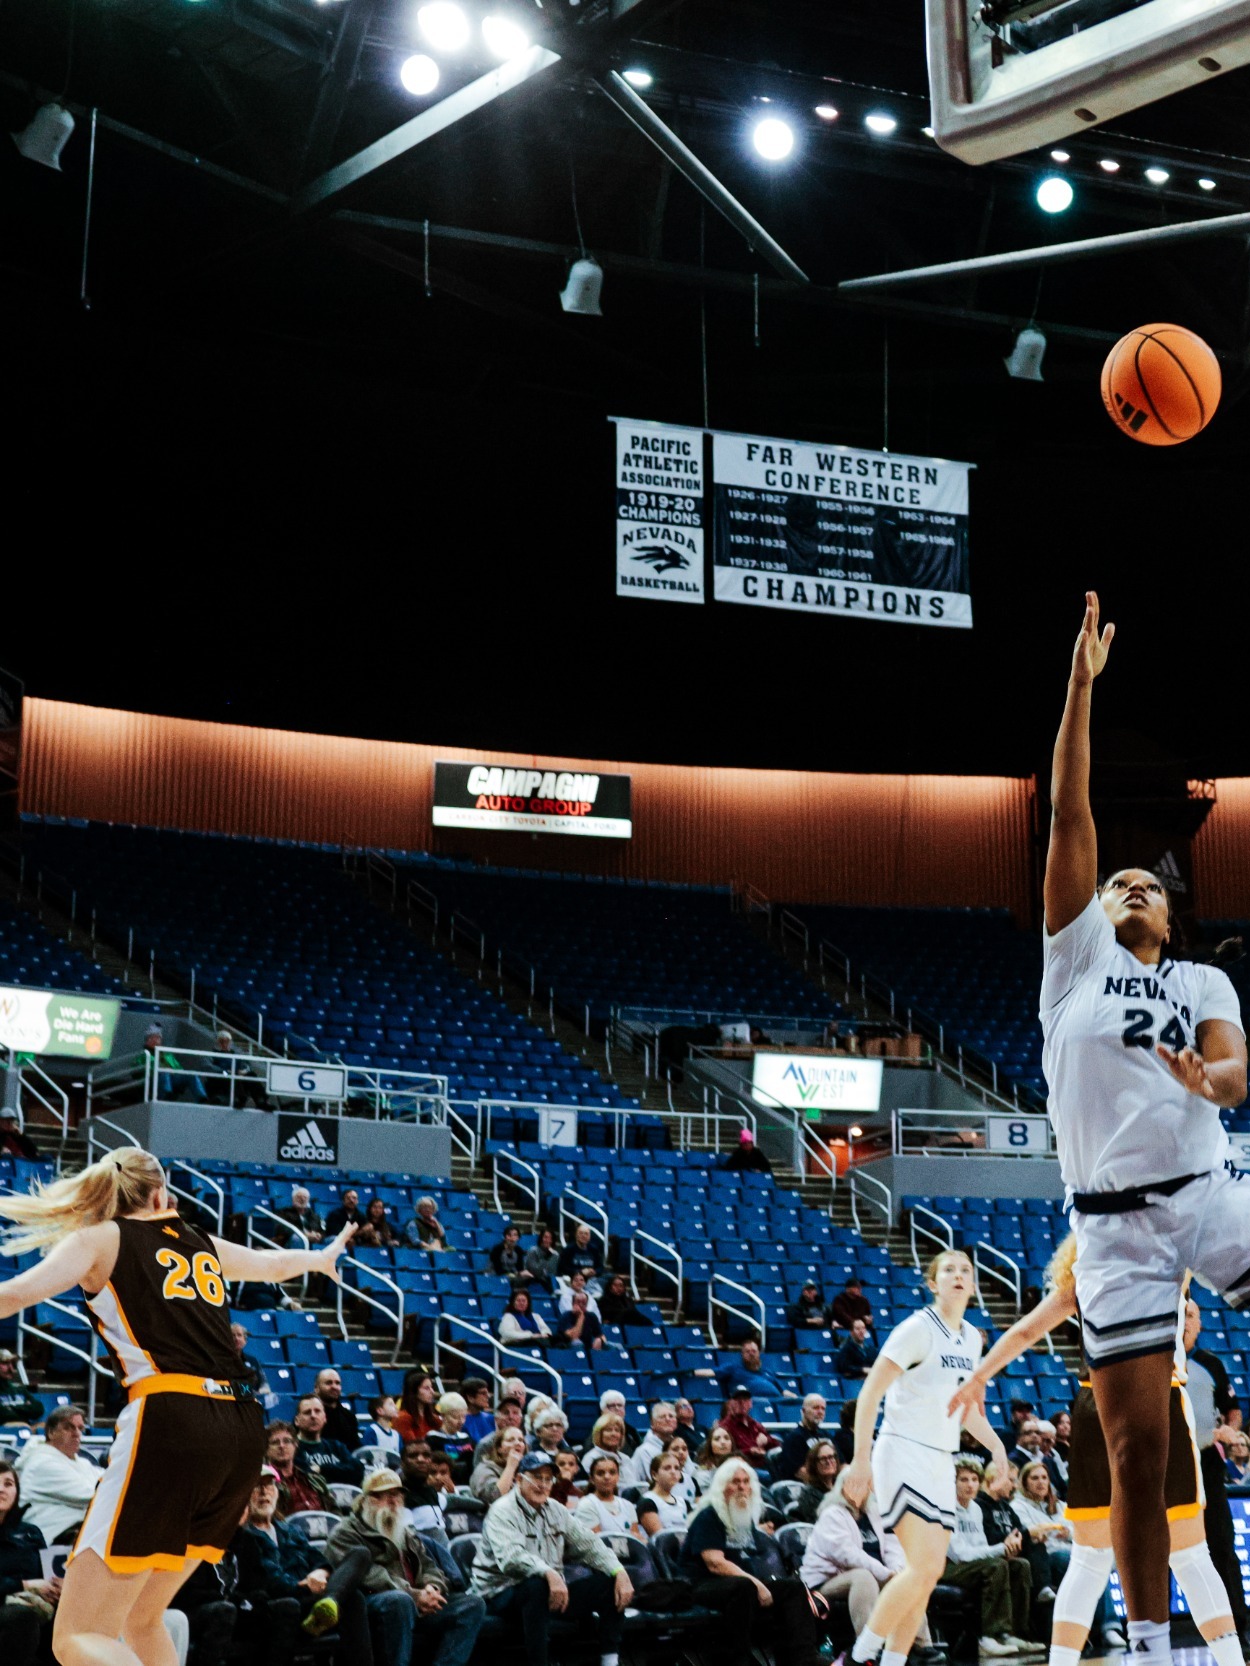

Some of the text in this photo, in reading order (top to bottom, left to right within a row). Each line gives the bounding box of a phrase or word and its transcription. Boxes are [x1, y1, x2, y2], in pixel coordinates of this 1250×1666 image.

[631, 435, 691, 455] PACIFIC
[623, 453, 698, 474] ATHLETIC
[747, 443, 938, 486] FAR WESTERN
[621, 471, 701, 490] ASSOCIATION
[765, 469, 920, 505] CONFERENCE
[629, 492, 695, 511] 1919-20
[619, 505, 701, 525] CHAMPIONS
[623, 527, 697, 554] NEVADA
[621, 575, 699, 592] BASKETBALL
[743, 576, 945, 618] CHAMPIONS
[466, 766, 600, 803] CAMPAGNI
[475, 795, 592, 816] AUTO GROUP
[512, 816, 547, 826] TOYOTA
[555, 818, 590, 830] CAPITAL
[594, 822, 617, 831] FORD
[60, 1006, 102, 1022] We Are
[53, 1018, 104, 1035] Die Hard
[1121, 1008, 1188, 1053] 24
[58, 1031, 85, 1045] Fans
[298, 1071, 316, 1092] 6
[781, 1060, 857, 1088] MOUNTAIN
[796, 1081, 844, 1102] WEST
[551, 1119, 565, 1139] 7
[1009, 1122, 1028, 1146] 8
[280, 1144, 335, 1161] adidas
[155, 1247, 226, 1307] 26
